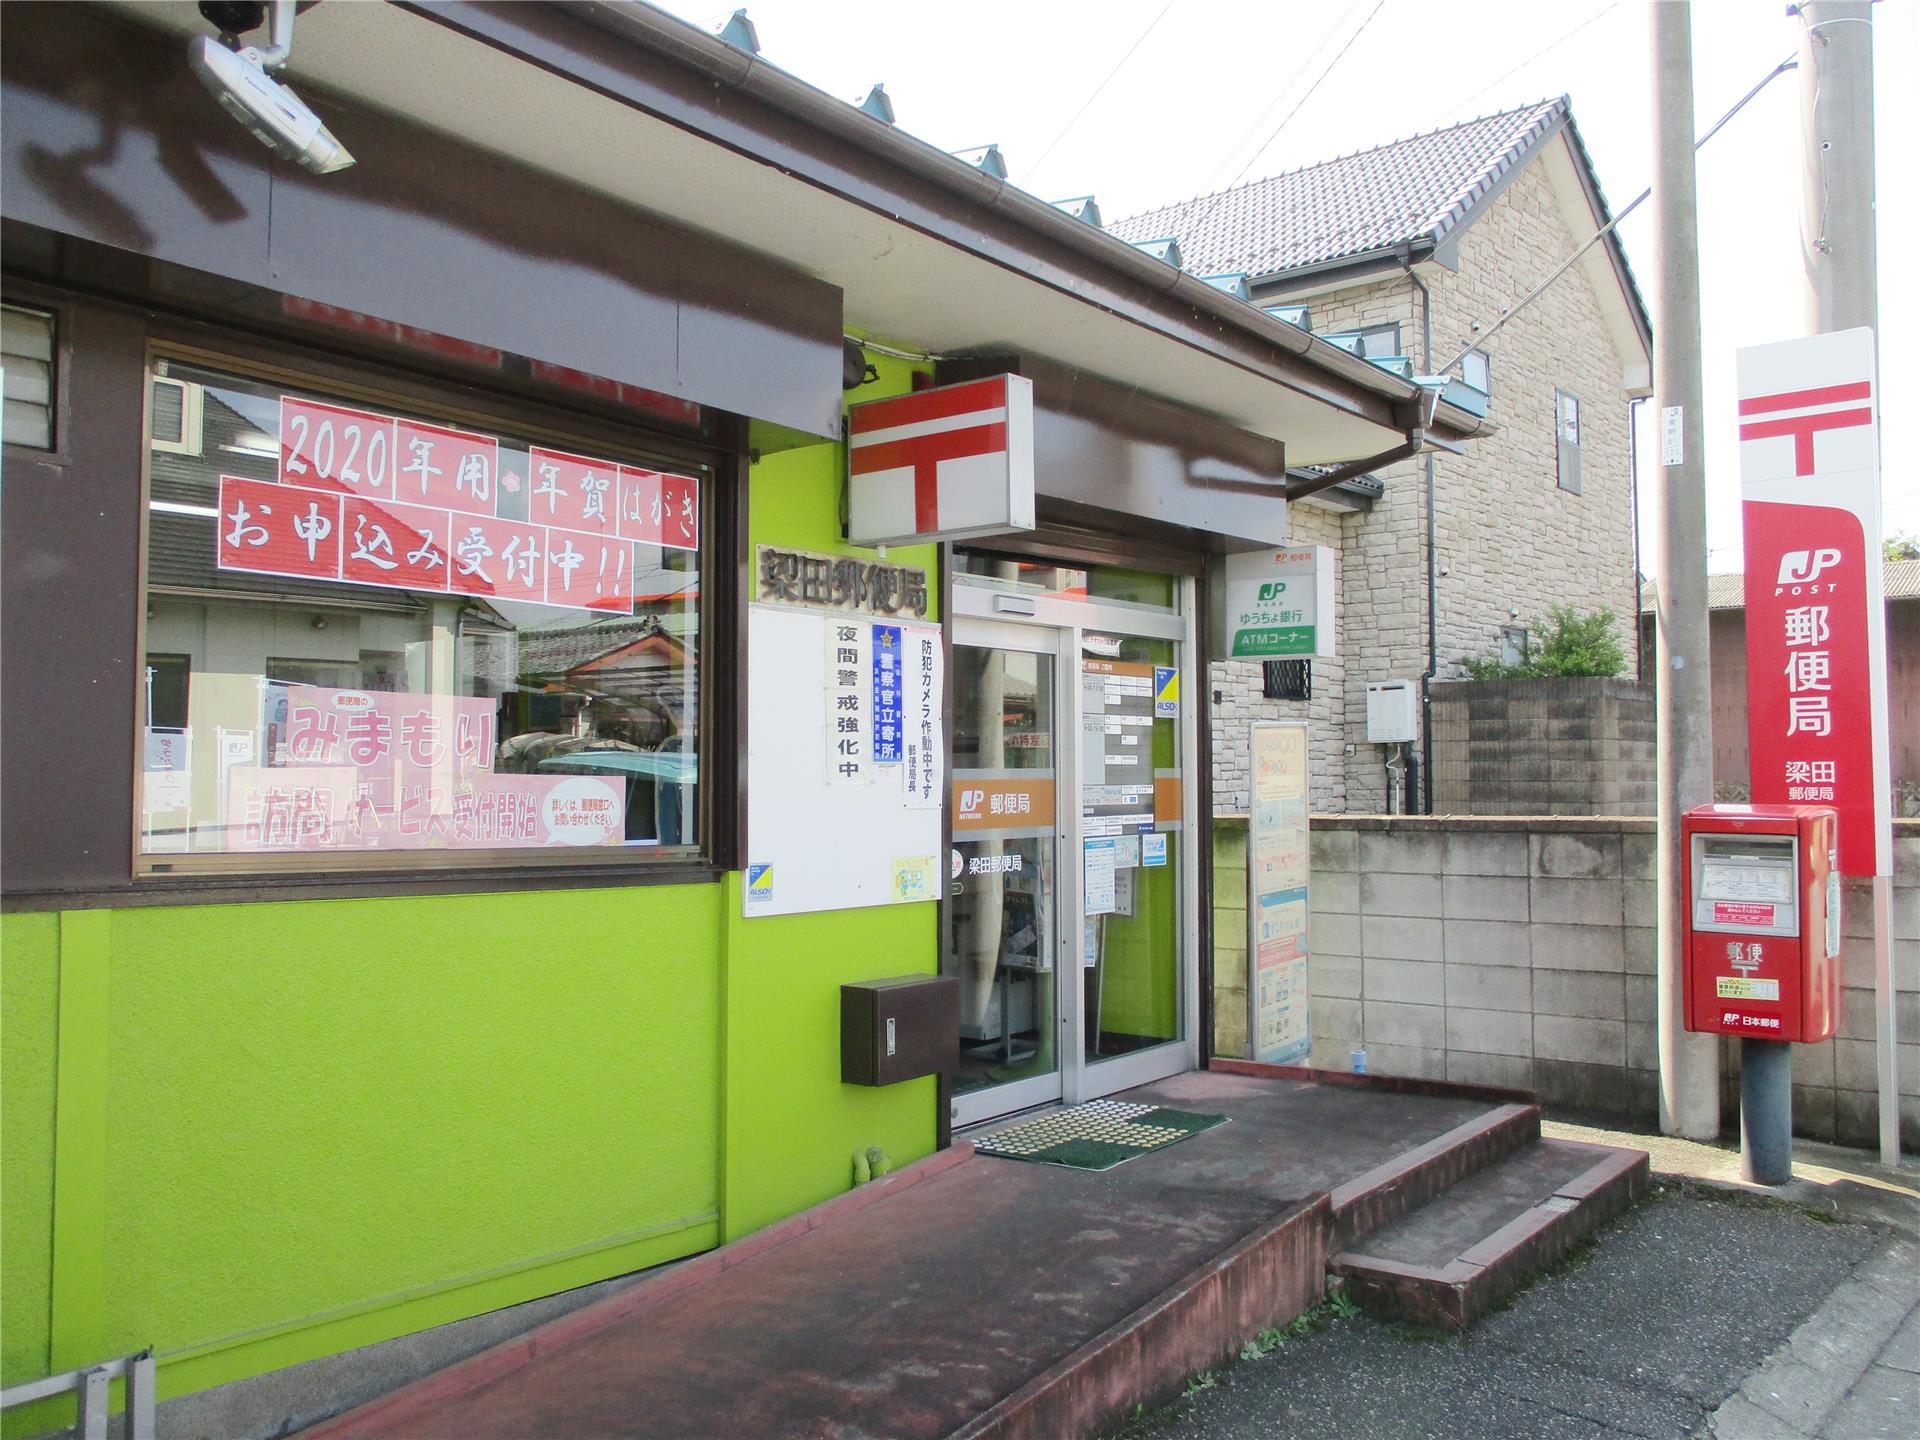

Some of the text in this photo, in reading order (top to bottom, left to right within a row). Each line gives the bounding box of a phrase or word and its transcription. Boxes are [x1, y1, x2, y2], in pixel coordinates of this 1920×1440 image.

[286, 414, 695, 538] 2020年用 年賀はがき
[1777, 548, 1841, 585] JP
[760, 549, 928, 616] 梁田郵便局
[1258, 582, 1286, 601] JP
[1774, 583, 1837, 597] POST
[1240, 609, 1303, 625] ゆうちょ銀行
[1241, 631, 1309, 646] ATMコーナー
[1784, 606, 1831, 737] 郵便局
[836, 625, 860, 778] 夜間警戒強化中
[880, 652, 895, 760] 警察官立寄所
[921, 639, 933, 800] 防犯カメラ作動中です
[290, 706, 494, 769] みまもり
[907, 744, 917, 793] 郵便局長
[1785, 761, 1836, 784] 梁田
[990, 793, 1030, 815] 郵便局
[1788, 786, 1834, 801] 郵便局
[969, 855, 1022, 875] 梁田郵便局
[1726, 942, 1763, 962] 郵便
[1742, 1016, 1780, 1029] 日本郵便
